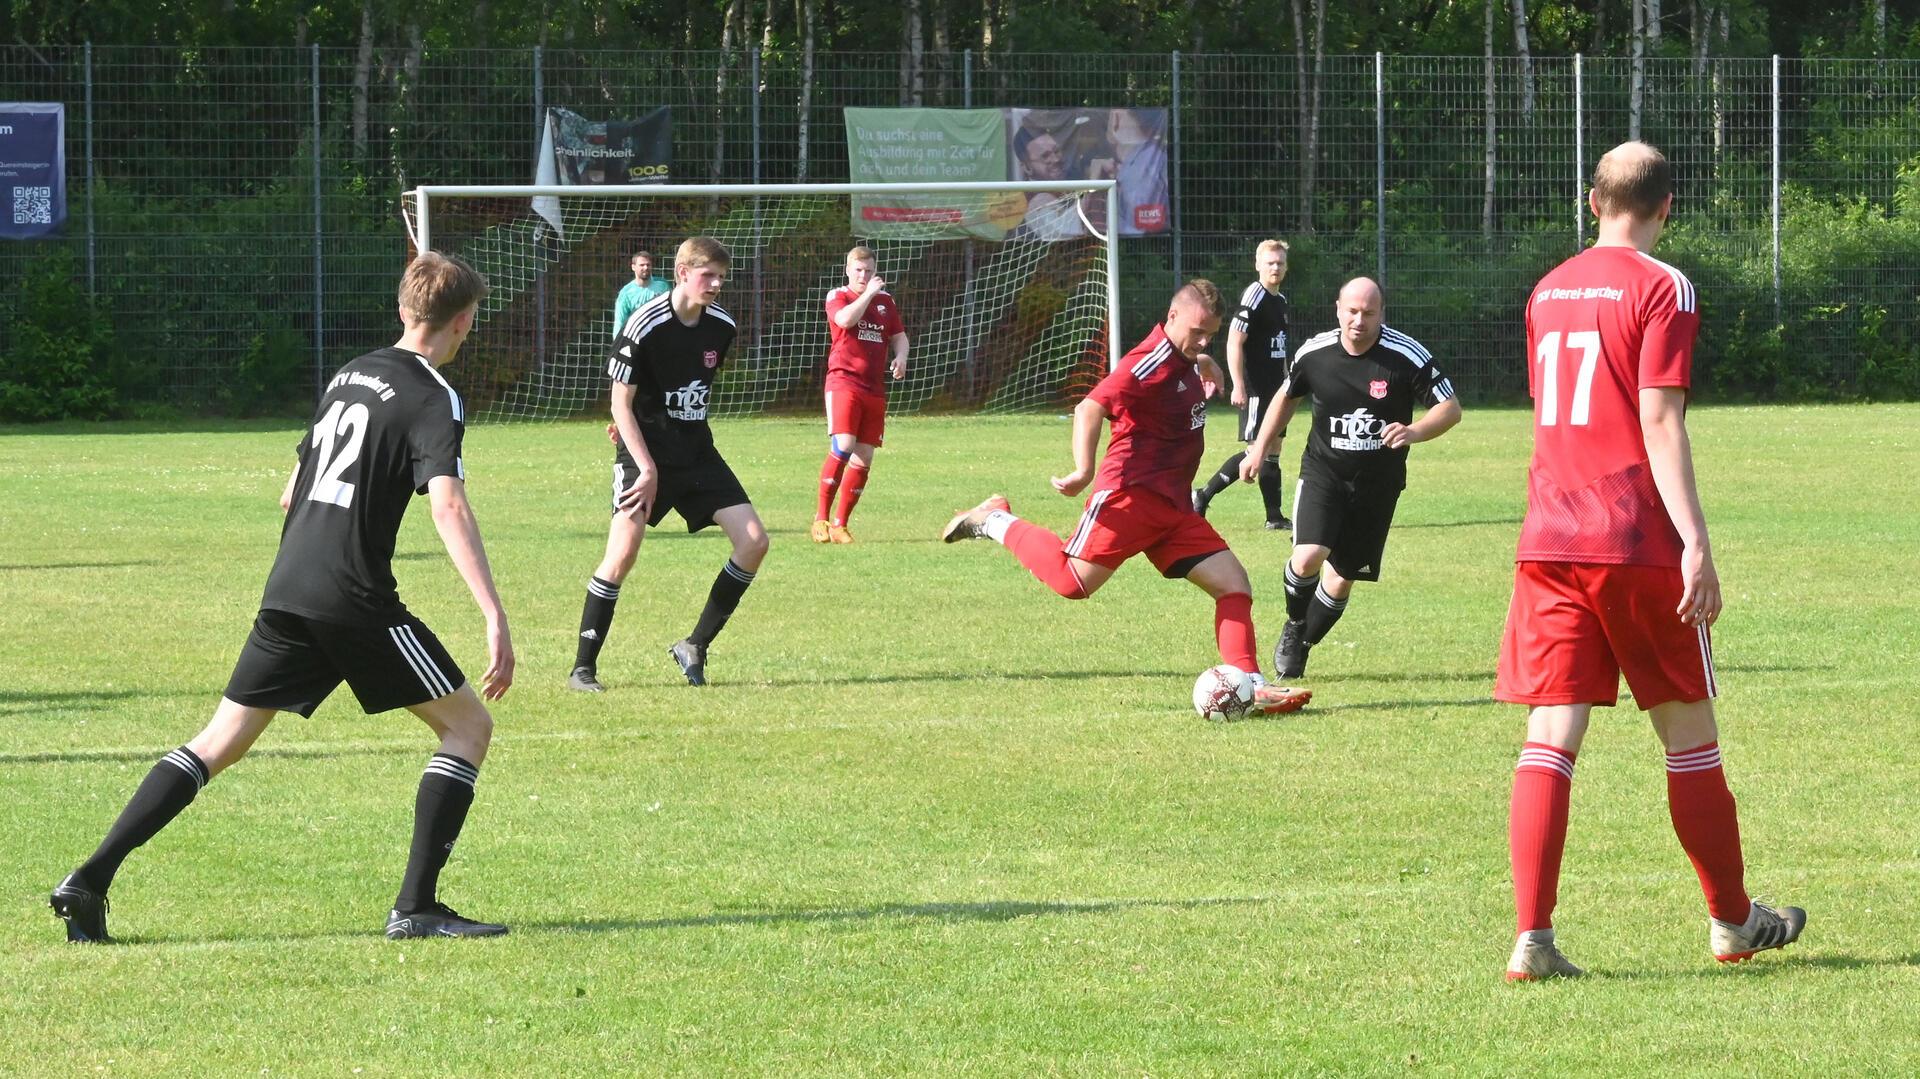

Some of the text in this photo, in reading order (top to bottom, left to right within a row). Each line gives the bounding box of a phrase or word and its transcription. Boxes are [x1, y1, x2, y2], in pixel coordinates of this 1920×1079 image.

[856, 127, 944, 141] Du suchst eine
[859, 145, 923, 160] Ausbildung
[927, 146, 946, 159] mit
[950, 145, 975, 159] Zeit
[628, 164, 669, 177] 100€
[887, 163, 909, 176] und
[912, 162, 937, 176] dein
[939, 162, 977, 176] Team?
[1537, 331, 1601, 426] 17
[307, 400, 369, 509] 12
